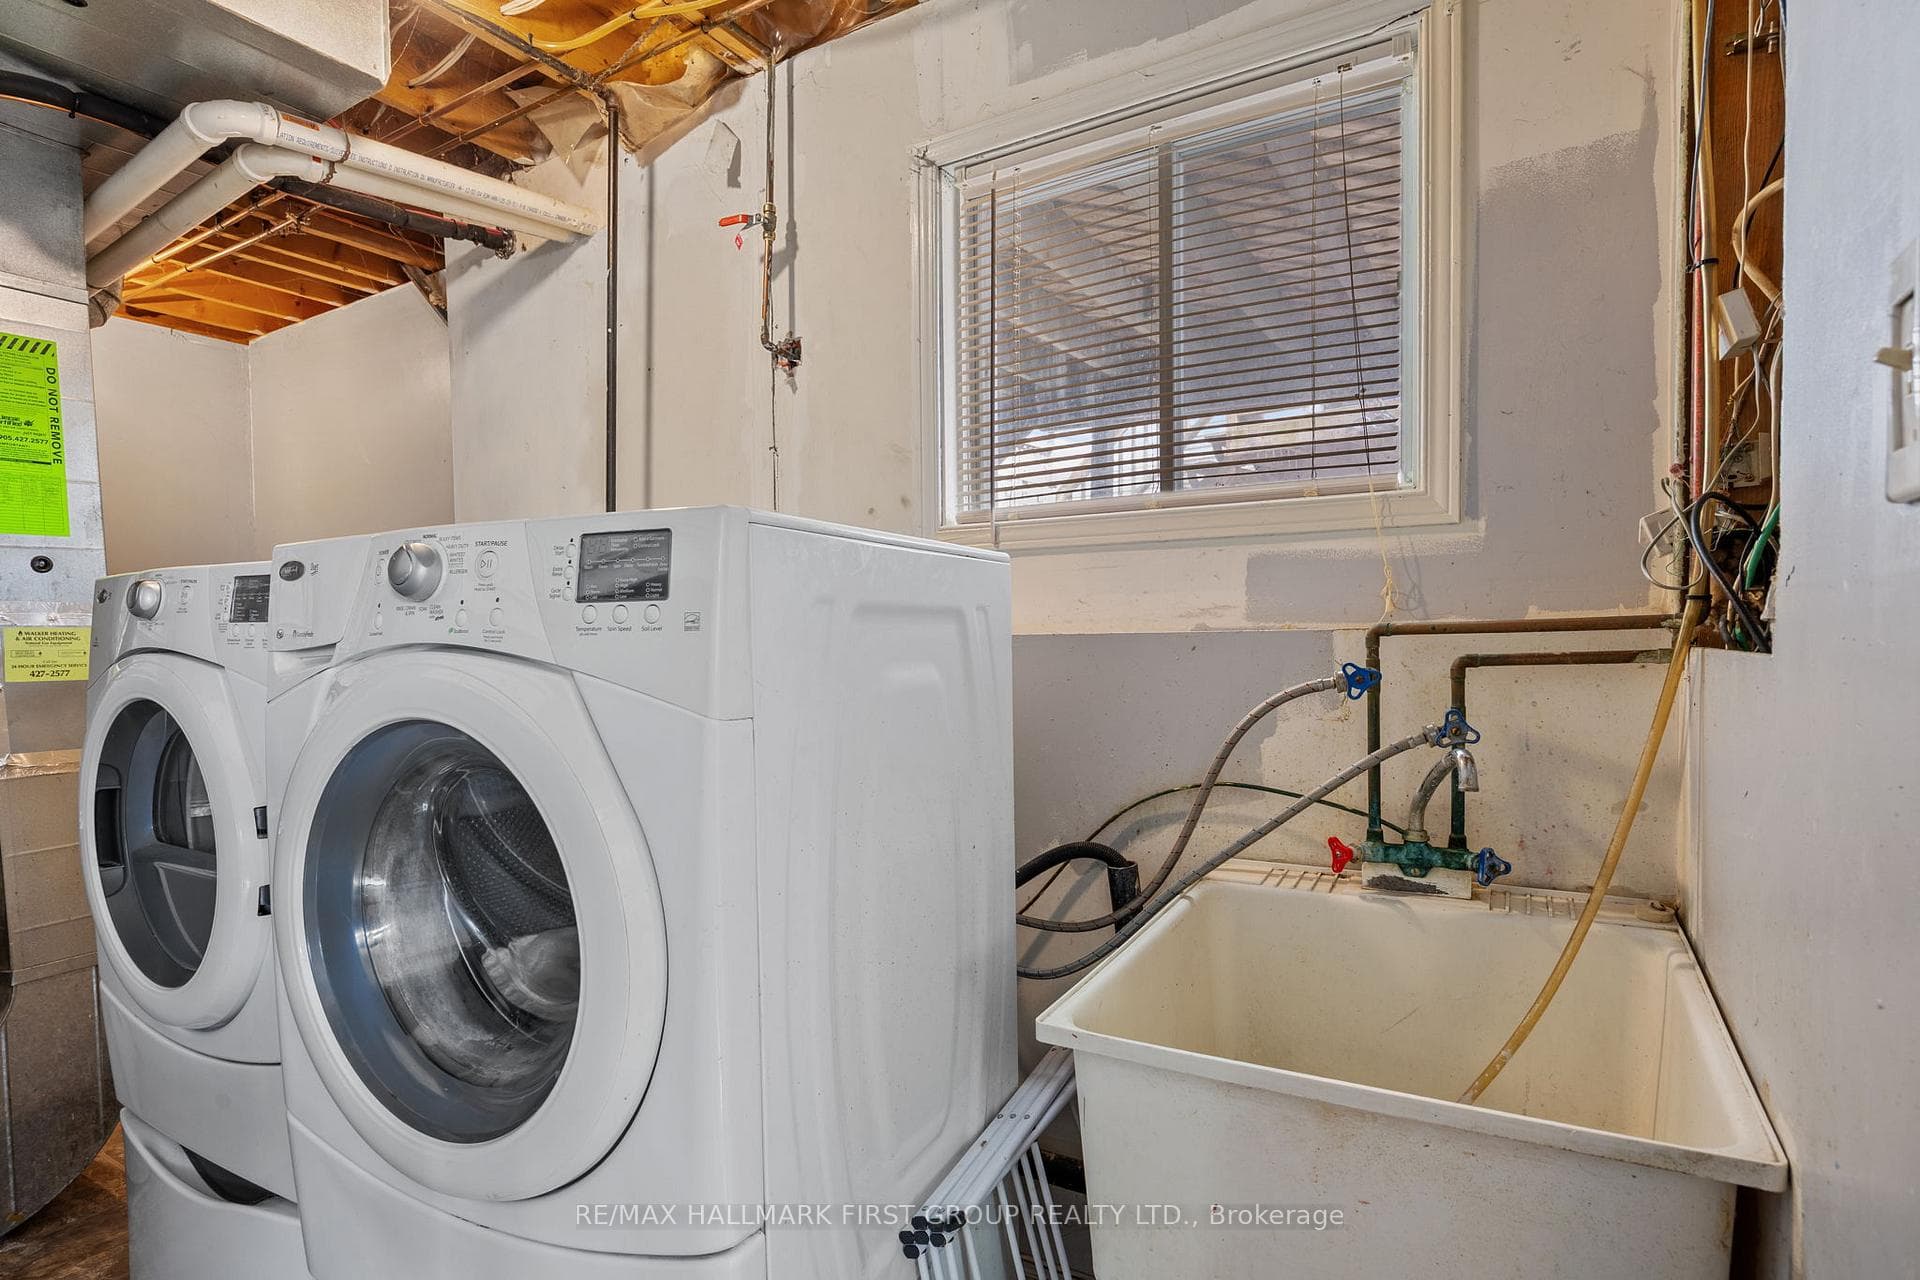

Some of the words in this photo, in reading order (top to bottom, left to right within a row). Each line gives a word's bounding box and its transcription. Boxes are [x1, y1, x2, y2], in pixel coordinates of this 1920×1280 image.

[46, 368, 56, 384] DO
[47, 388, 59, 413] NOT
[49, 417, 63, 464] REMOVE
[29, 669, 71, 677] 427-2577
